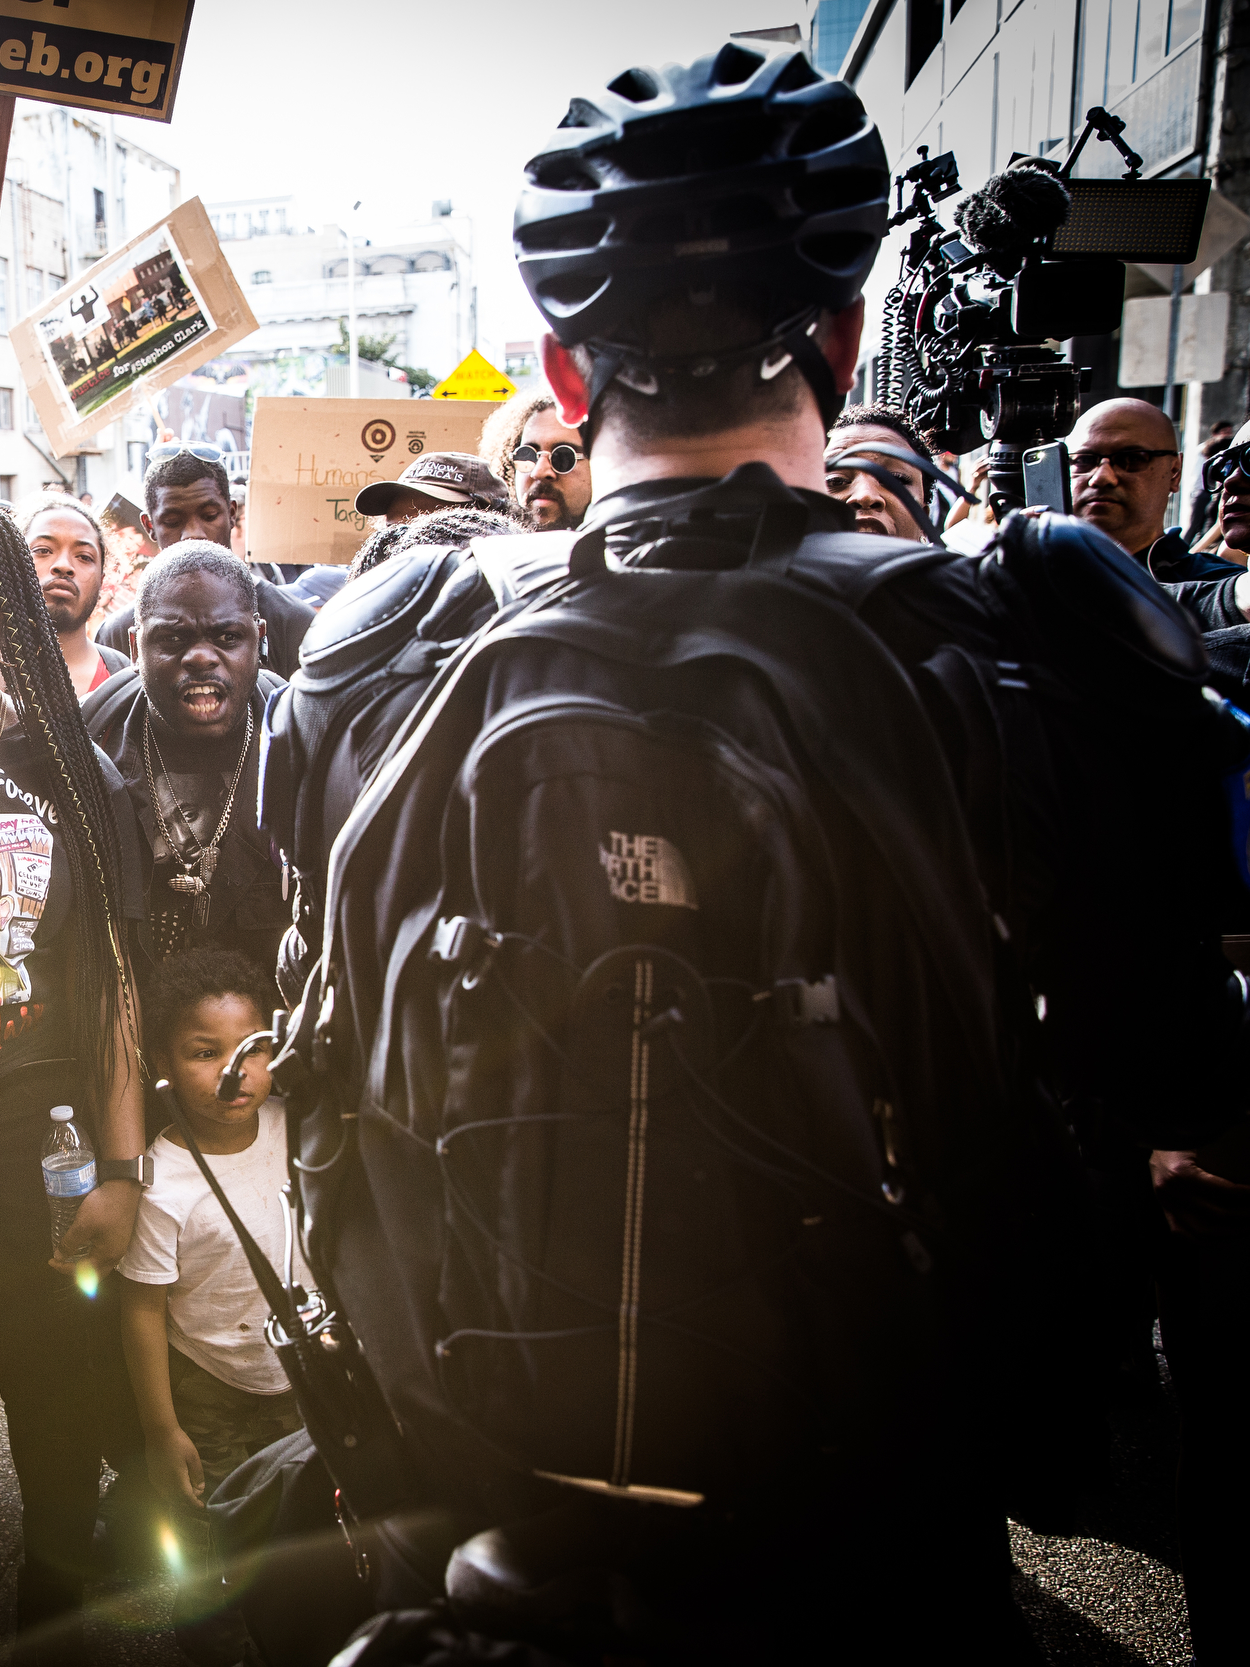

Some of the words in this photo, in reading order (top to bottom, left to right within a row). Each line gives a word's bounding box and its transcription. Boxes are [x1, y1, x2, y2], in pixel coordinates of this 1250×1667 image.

[71, 367, 111, 400] Justice
[112, 362, 130, 378] for
[173, 319, 205, 344] Clark
[456, 369, 496, 380] WATCH
[464, 387, 487, 396] FOR
[454, 472, 464, 482] IS
[610, 831, 658, 857] THE
